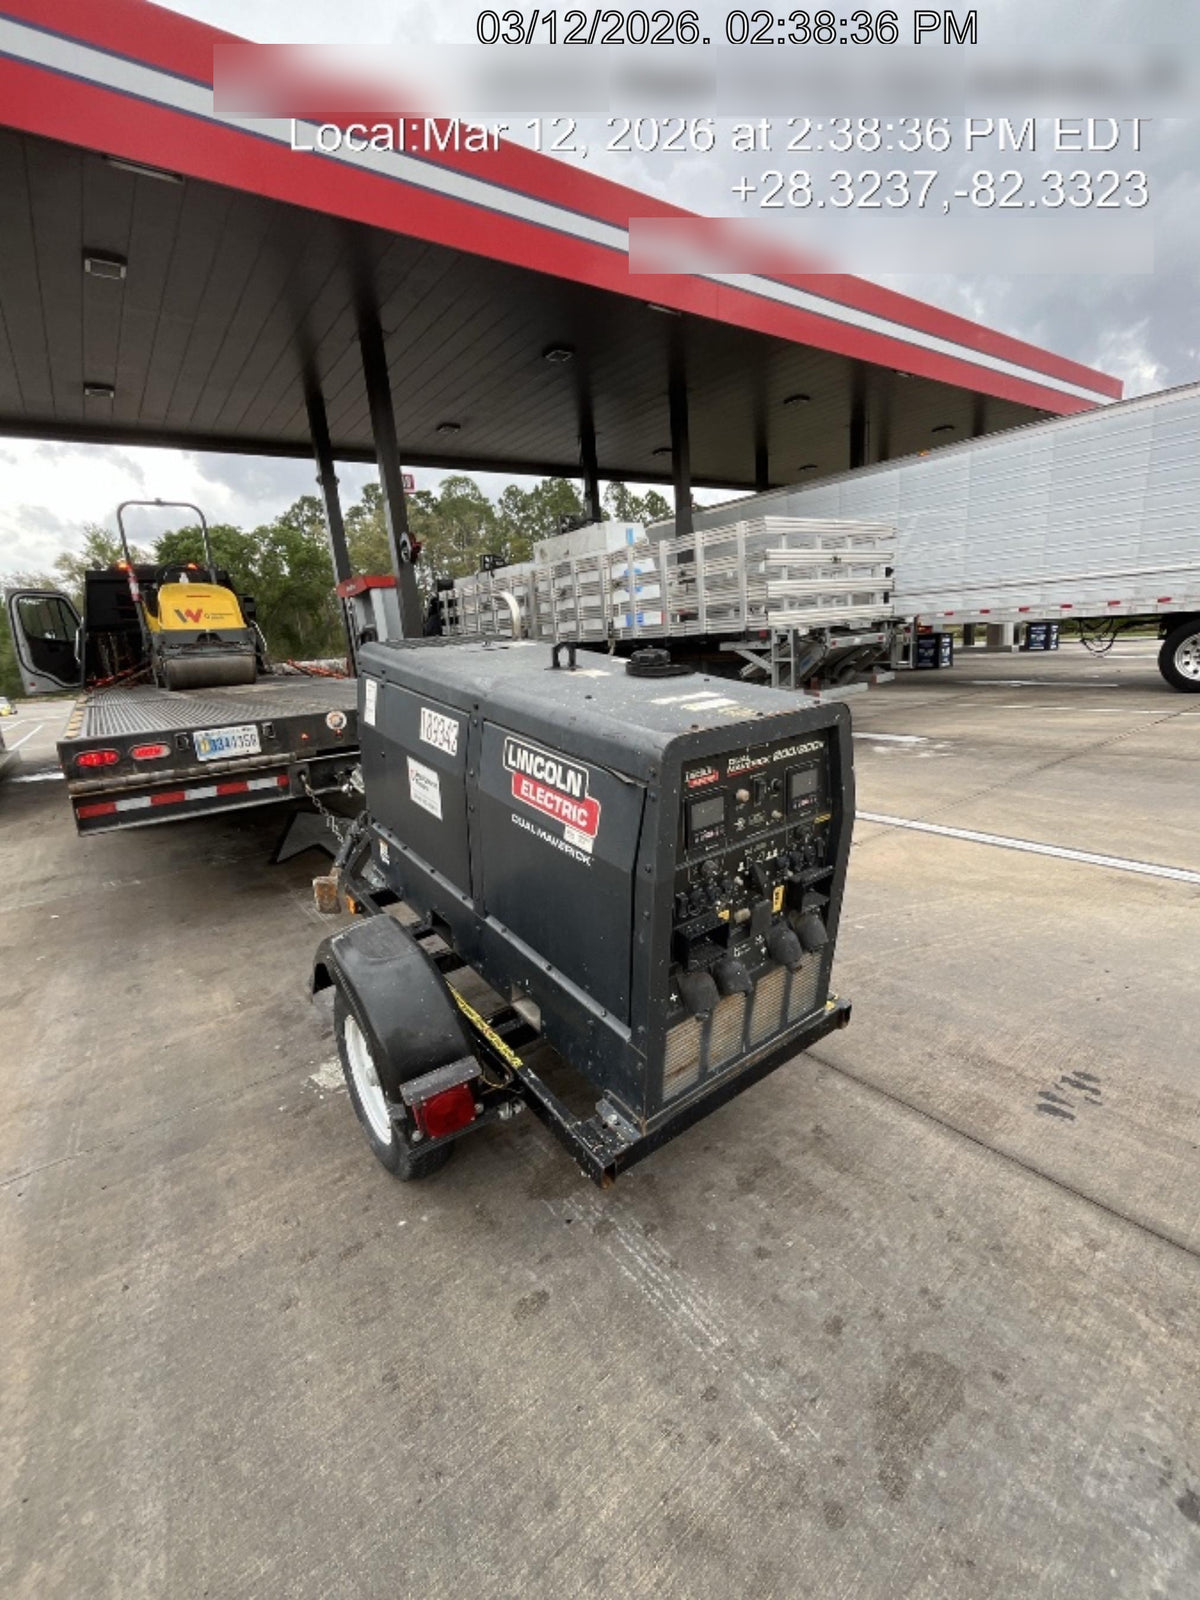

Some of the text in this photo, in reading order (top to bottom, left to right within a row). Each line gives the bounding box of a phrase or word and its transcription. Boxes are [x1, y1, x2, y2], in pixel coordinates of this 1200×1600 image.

[507, 744, 583, 797] LINCOLN
[511, 813, 537, 835] DUAL
[520, 778, 589, 827] ELECTRIC
